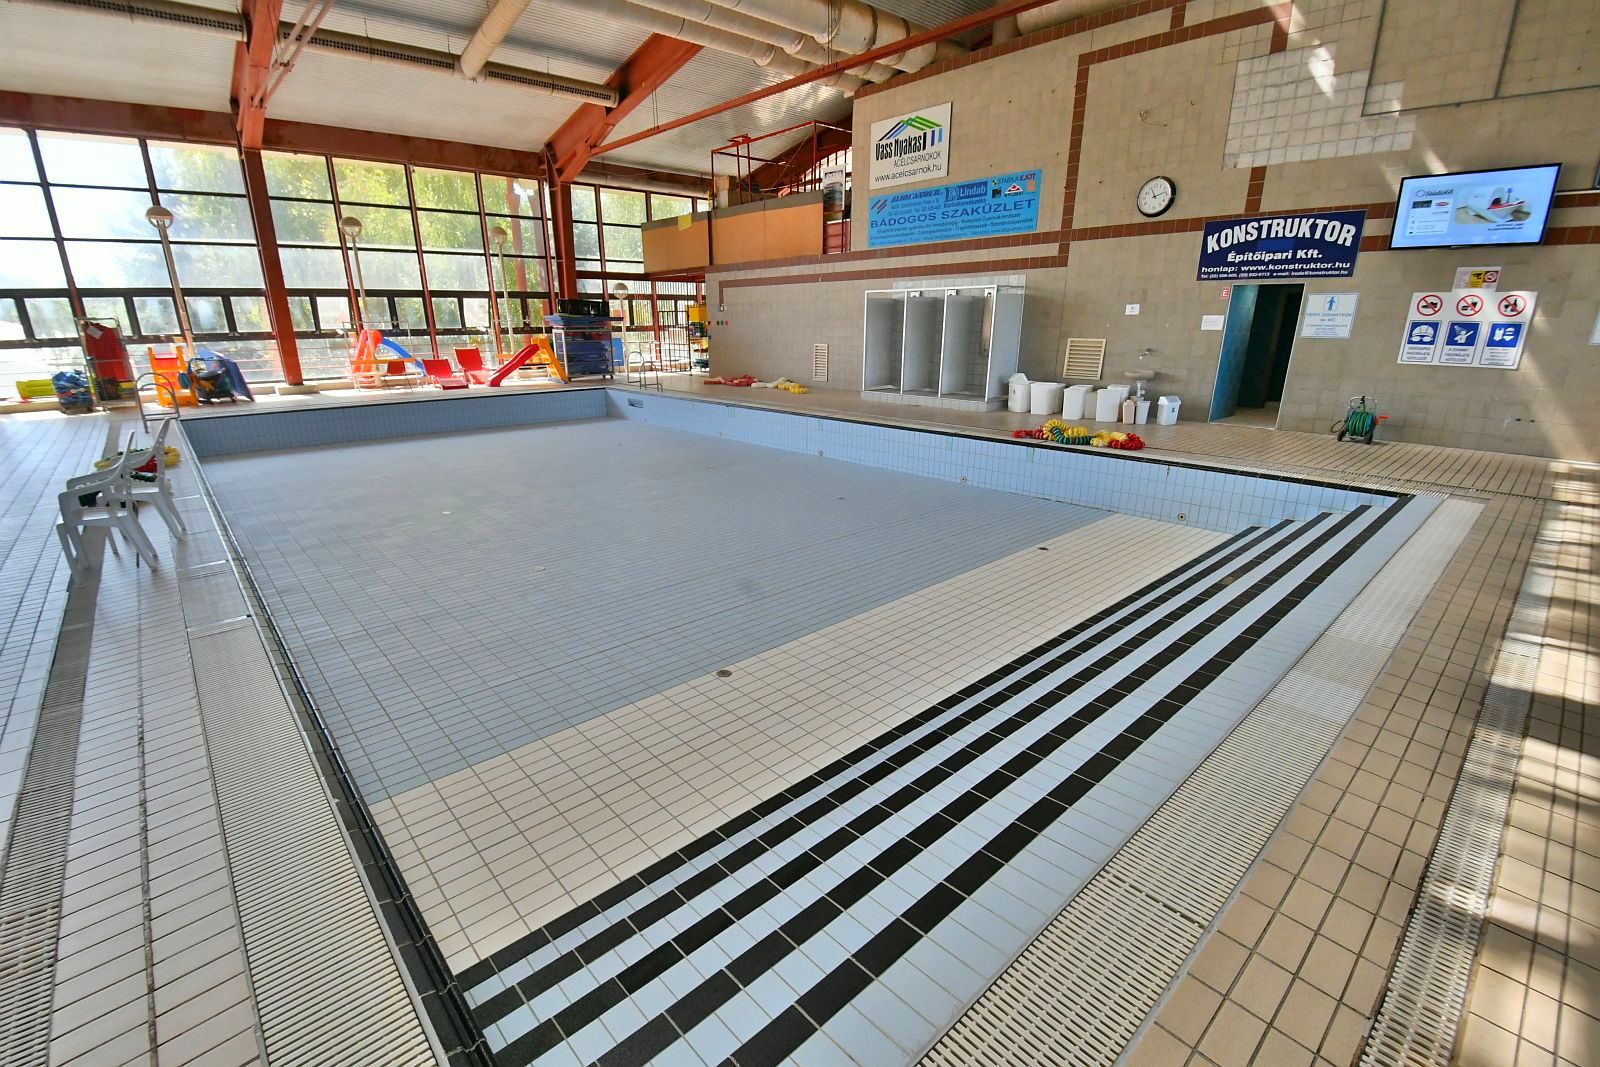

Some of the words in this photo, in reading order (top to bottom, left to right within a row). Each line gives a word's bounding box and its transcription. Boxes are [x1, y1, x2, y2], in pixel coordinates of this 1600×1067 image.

[875, 142, 893, 161] Vass
[894, 135, 922, 158] Nyakas
[874, 163, 942, 182] www.acelcsarnok.hu
[959, 184, 986, 197] Lindab
[871, 212, 936, 228] BÁDOGOS
[941, 199, 1036, 219] SZAKÜZLET
[1207, 218, 1356, 254] KONSTRUKTOR
[1227, 250, 1292, 263] Építőipari
[1296, 249, 1323, 259] Kft.
[1241, 262, 1350, 271] www.konstruktor.hu
